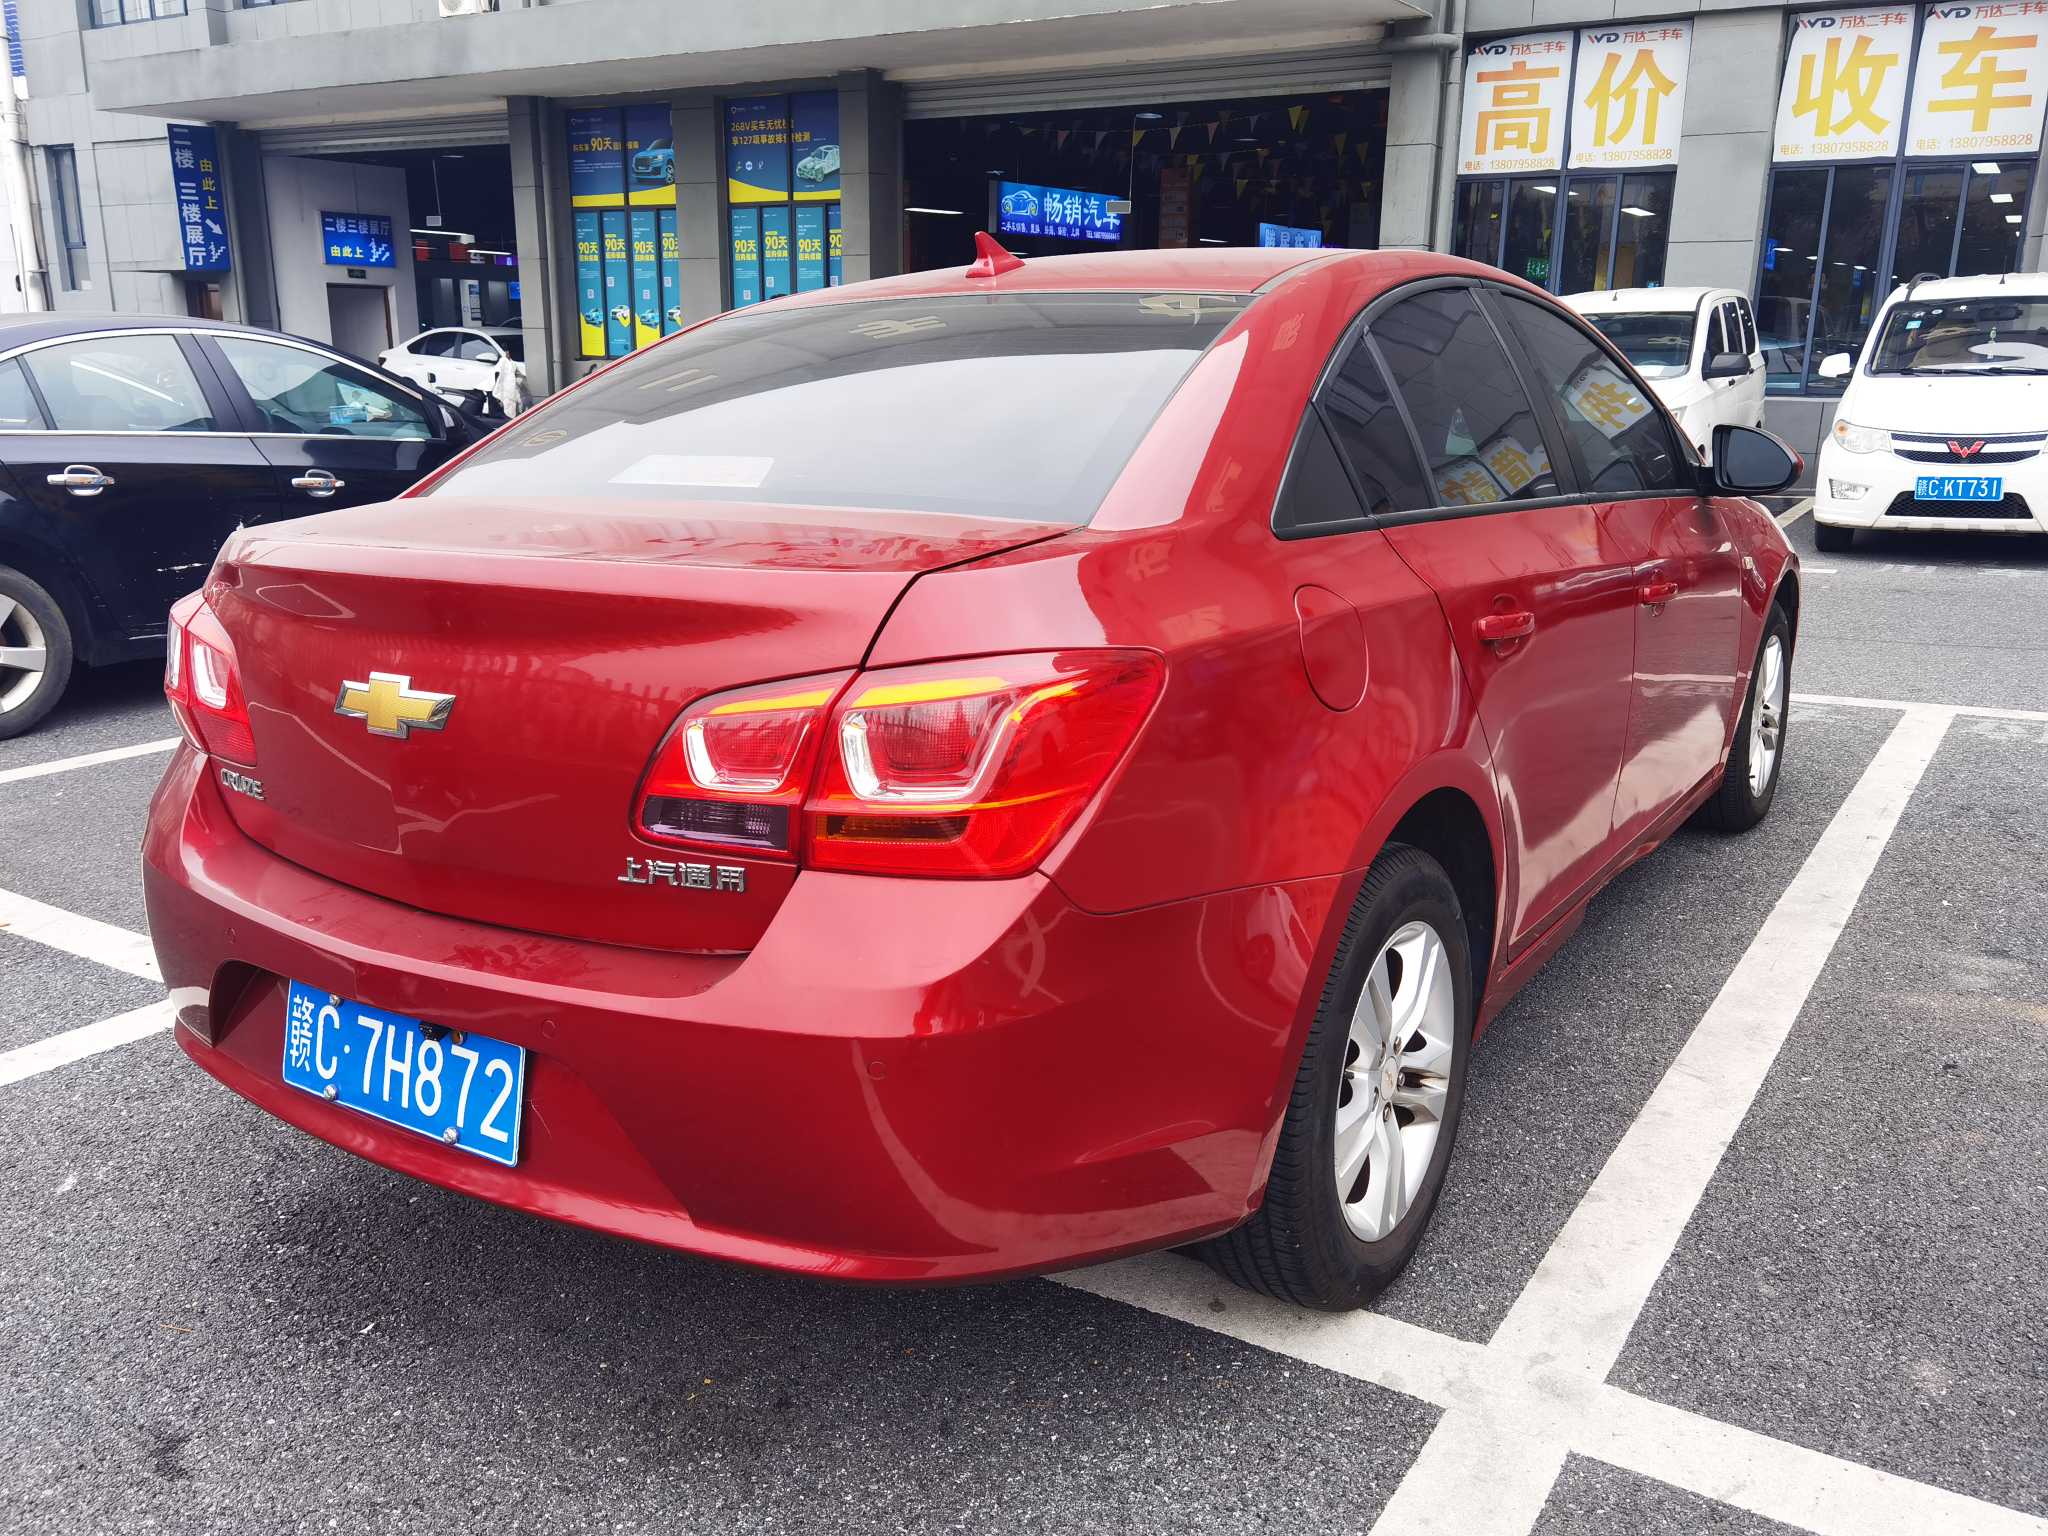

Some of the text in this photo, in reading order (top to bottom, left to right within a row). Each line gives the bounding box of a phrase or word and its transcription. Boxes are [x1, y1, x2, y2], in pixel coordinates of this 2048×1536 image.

[1975, 1, 2047, 19] 万达二手车
[1839, 12, 1907, 29] 万达二手车
[1623, 28, 1683, 44] 万达二手车
[1510, 40, 1568, 56] 万达二手车
[1792, 35, 1898, 137] 收
[1927, 25, 2038, 132] 车
[1584, 48, 1678, 147] 价
[1475, 61, 1560, 155] 高
[1811, 140, 1889, 155] 13807958828
[1949, 134, 2033, 148] 13807958828
[1602, 148, 1673, 162] 13807958828
[1489, 158, 1555, 171] 13807958828
[200, 159, 220, 210] 由此上
[1044, 191, 1121, 231] 畅销汽车
[179, 181, 207, 266] 三楼展厅
[324, 217, 391, 236] 二楼三楼展厅
[578, 242, 599, 254] 90天
[605, 238, 626, 252] 90天
[634, 241, 655, 254] 90天
[735, 240, 757, 253] 90天
[765, 236, 788, 250] 90天
[799, 239, 822, 253] 90天
[330, 245, 365, 258] 由此上
[221, 768, 264, 800] CRUZE
[617, 857, 745, 892] 上汽通用
